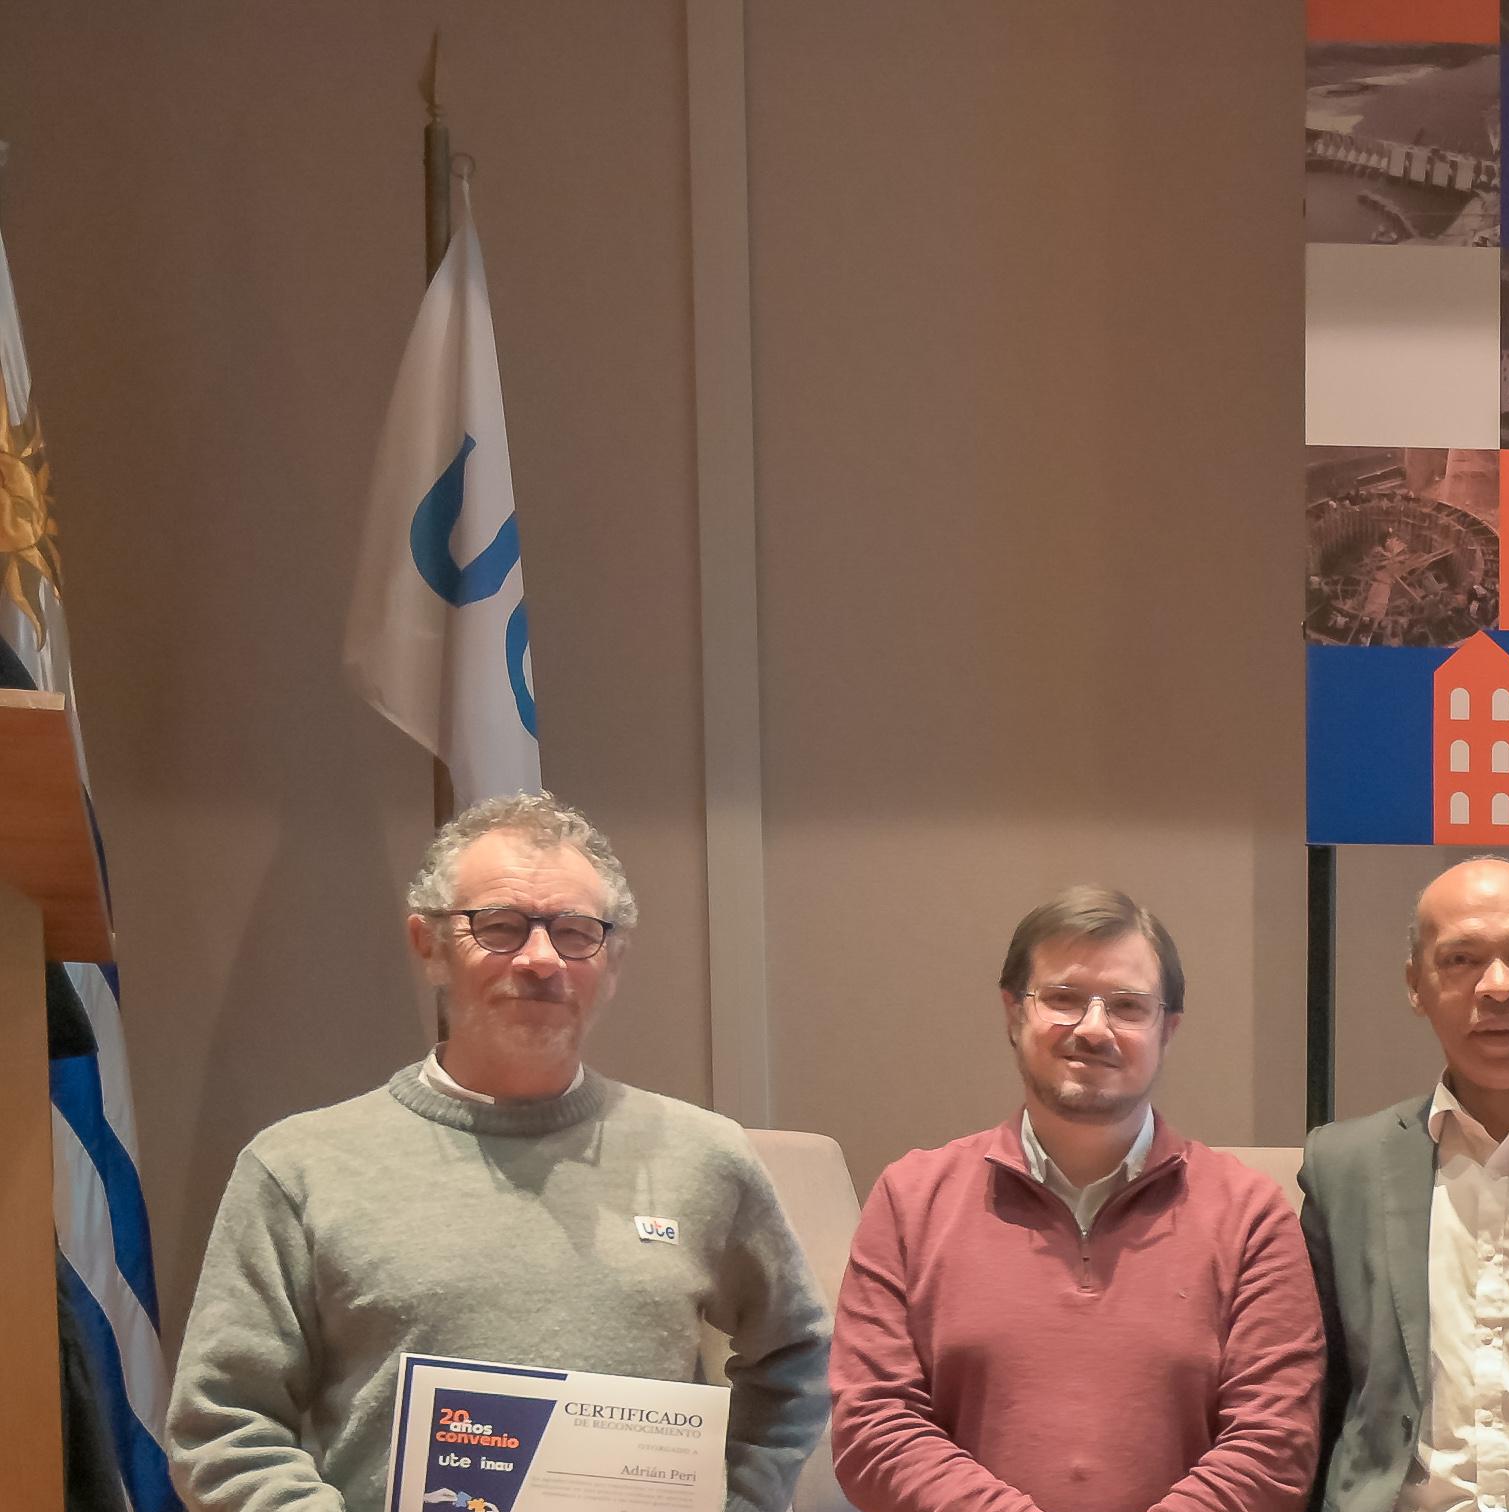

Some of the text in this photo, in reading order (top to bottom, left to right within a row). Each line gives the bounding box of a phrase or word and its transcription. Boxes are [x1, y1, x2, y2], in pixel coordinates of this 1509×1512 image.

[642, 1220, 675, 1240] ute
[439, 1408, 470, 1425] 20
[565, 1402, 703, 1428] CERTIFICADO
[449, 1419, 493, 1436] años
[573, 1418, 702, 1440] DE RECONOCIMIENTO
[435, 1430, 520, 1449] convenio
[438, 1452, 472, 1468] ute
[620, 1464, 697, 1482] Adrián Peri
